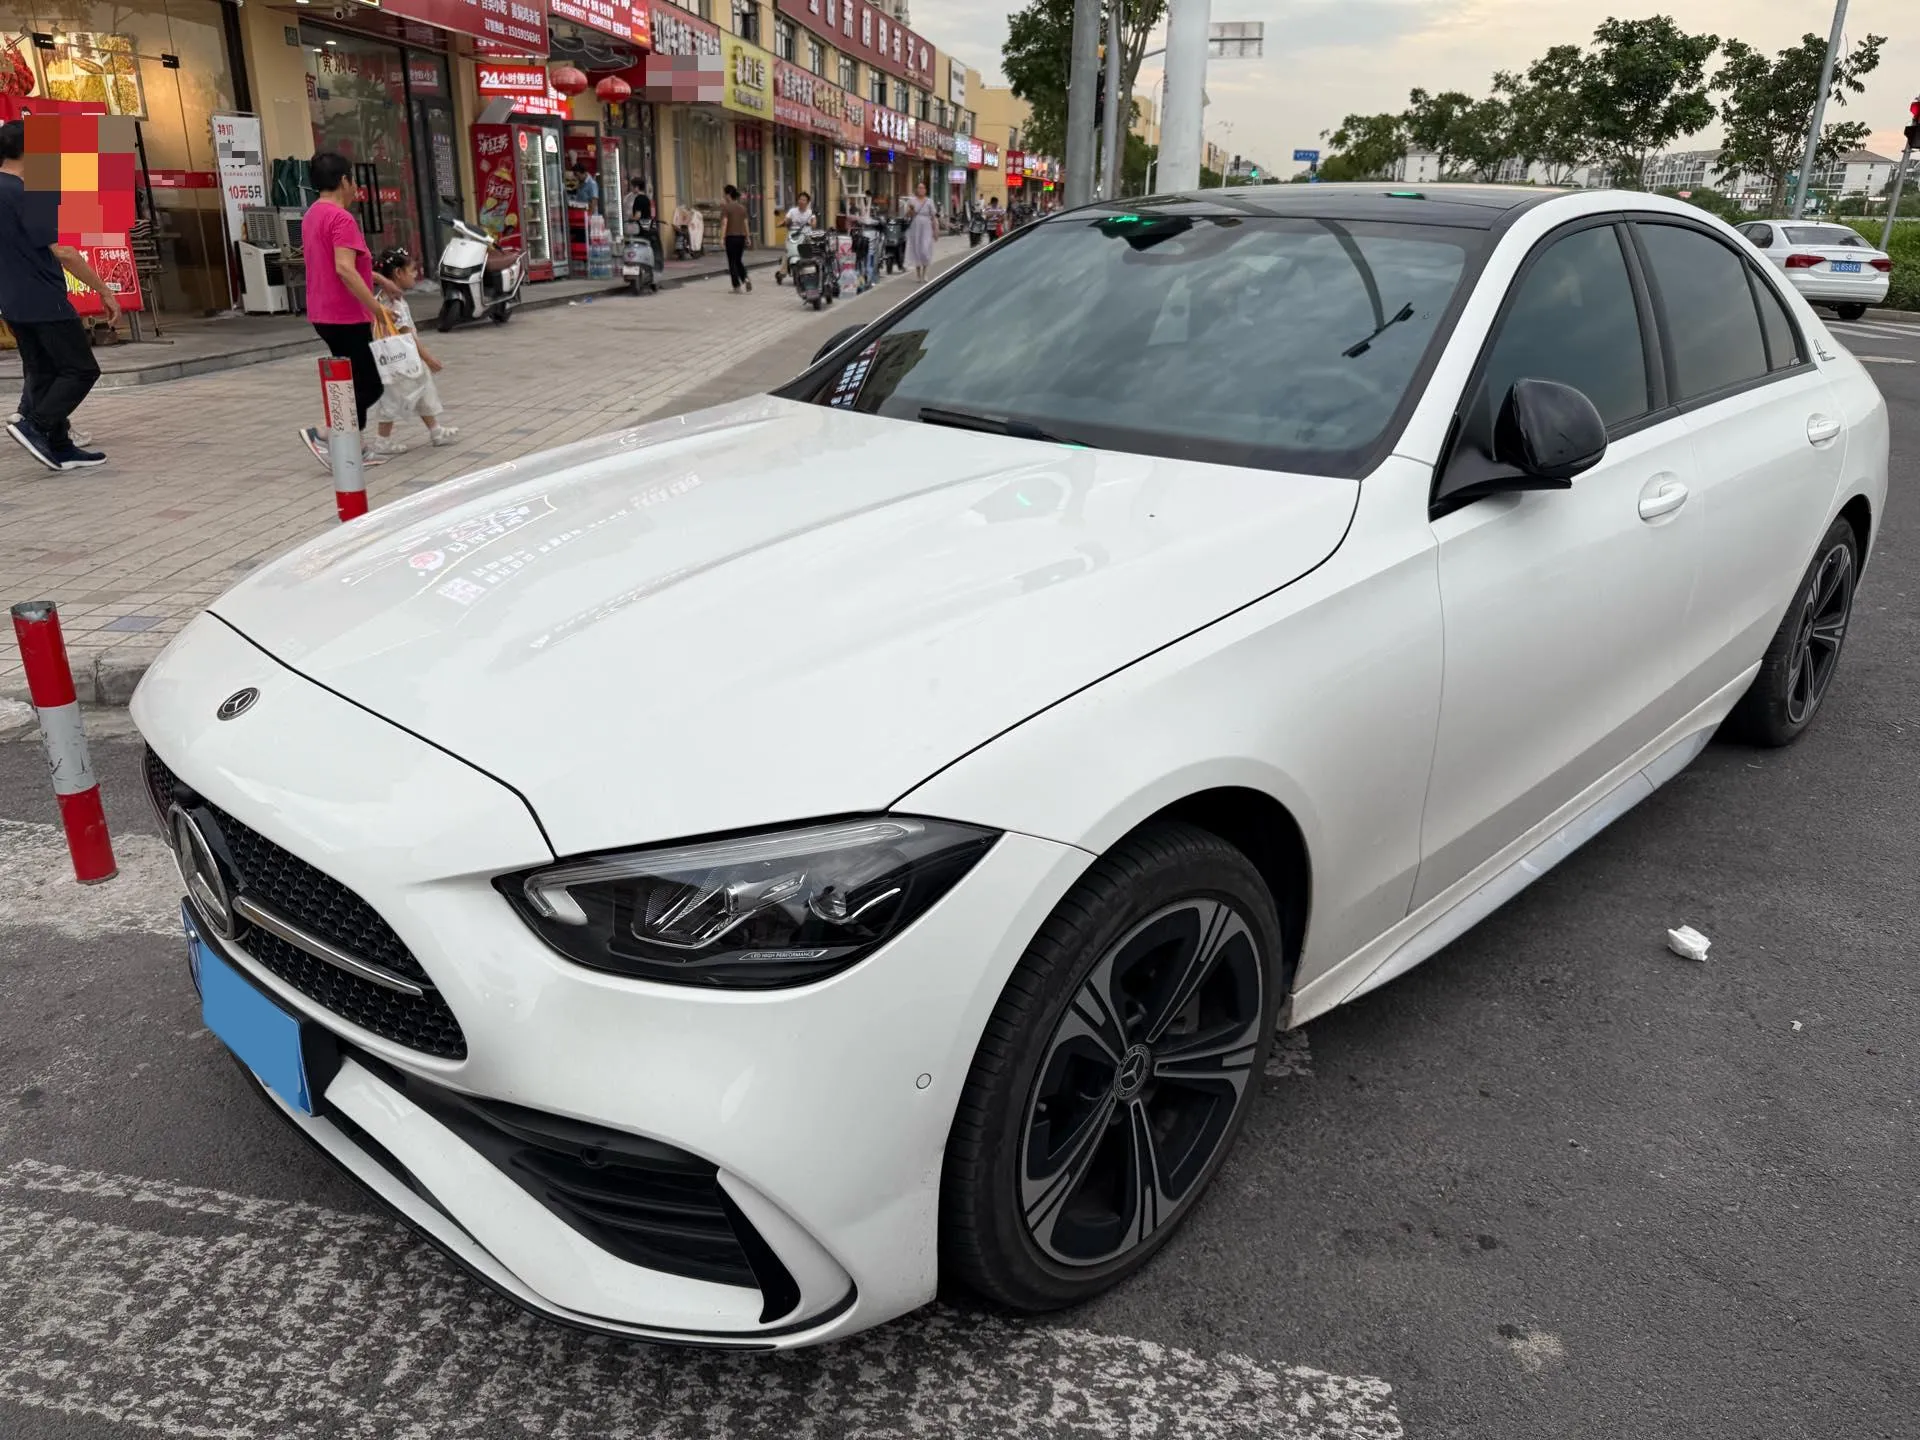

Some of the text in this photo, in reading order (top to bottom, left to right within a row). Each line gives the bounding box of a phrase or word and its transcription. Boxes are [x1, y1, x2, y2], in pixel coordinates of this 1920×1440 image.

[479, 70, 544, 88] 24小时便利店
[228, 184, 263, 200] 10元5只
